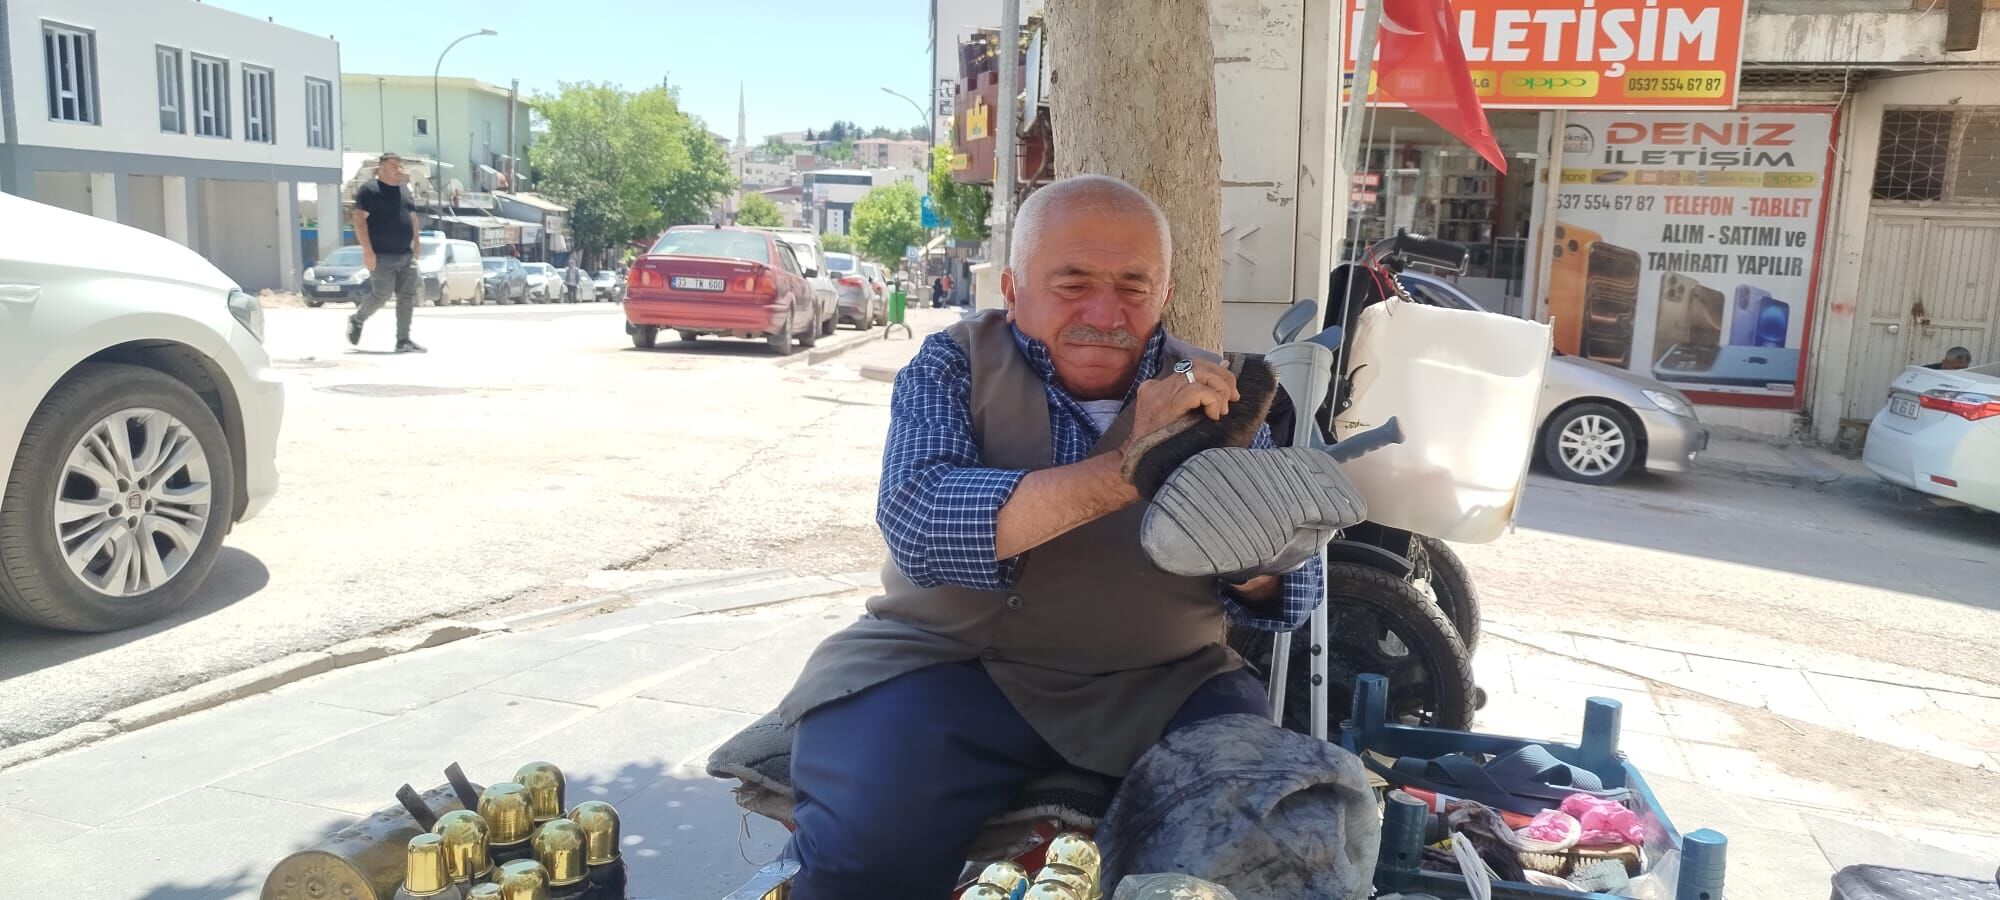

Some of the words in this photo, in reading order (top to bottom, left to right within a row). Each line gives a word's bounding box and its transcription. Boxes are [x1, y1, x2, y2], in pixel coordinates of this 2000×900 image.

[1440, 0, 1720, 77] LETİŞİM
[1628, 78, 1658, 91] 0537
[1661, 78, 1683, 91] 554
[1687, 78, 1702, 91] 67
[1705, 78, 1721, 91] 87
[1605, 117, 1796, 146] DENİZ
[1603, 146, 1796, 171] İLETİŞİM
[1584, 194, 1611, 211] 554
[1615, 195, 1633, 211] 67
[1636, 195, 1656, 212] 87
[1663, 195, 1735, 216] TELEFON
[1661, 224, 1705, 244] ALIM
[1718, 225, 1781, 247] SATIMI
[1784, 230, 1807, 248] ve
[1648, 249, 1729, 273] TAMİRATI
[1736, 255, 1804, 277] YAPILIR
